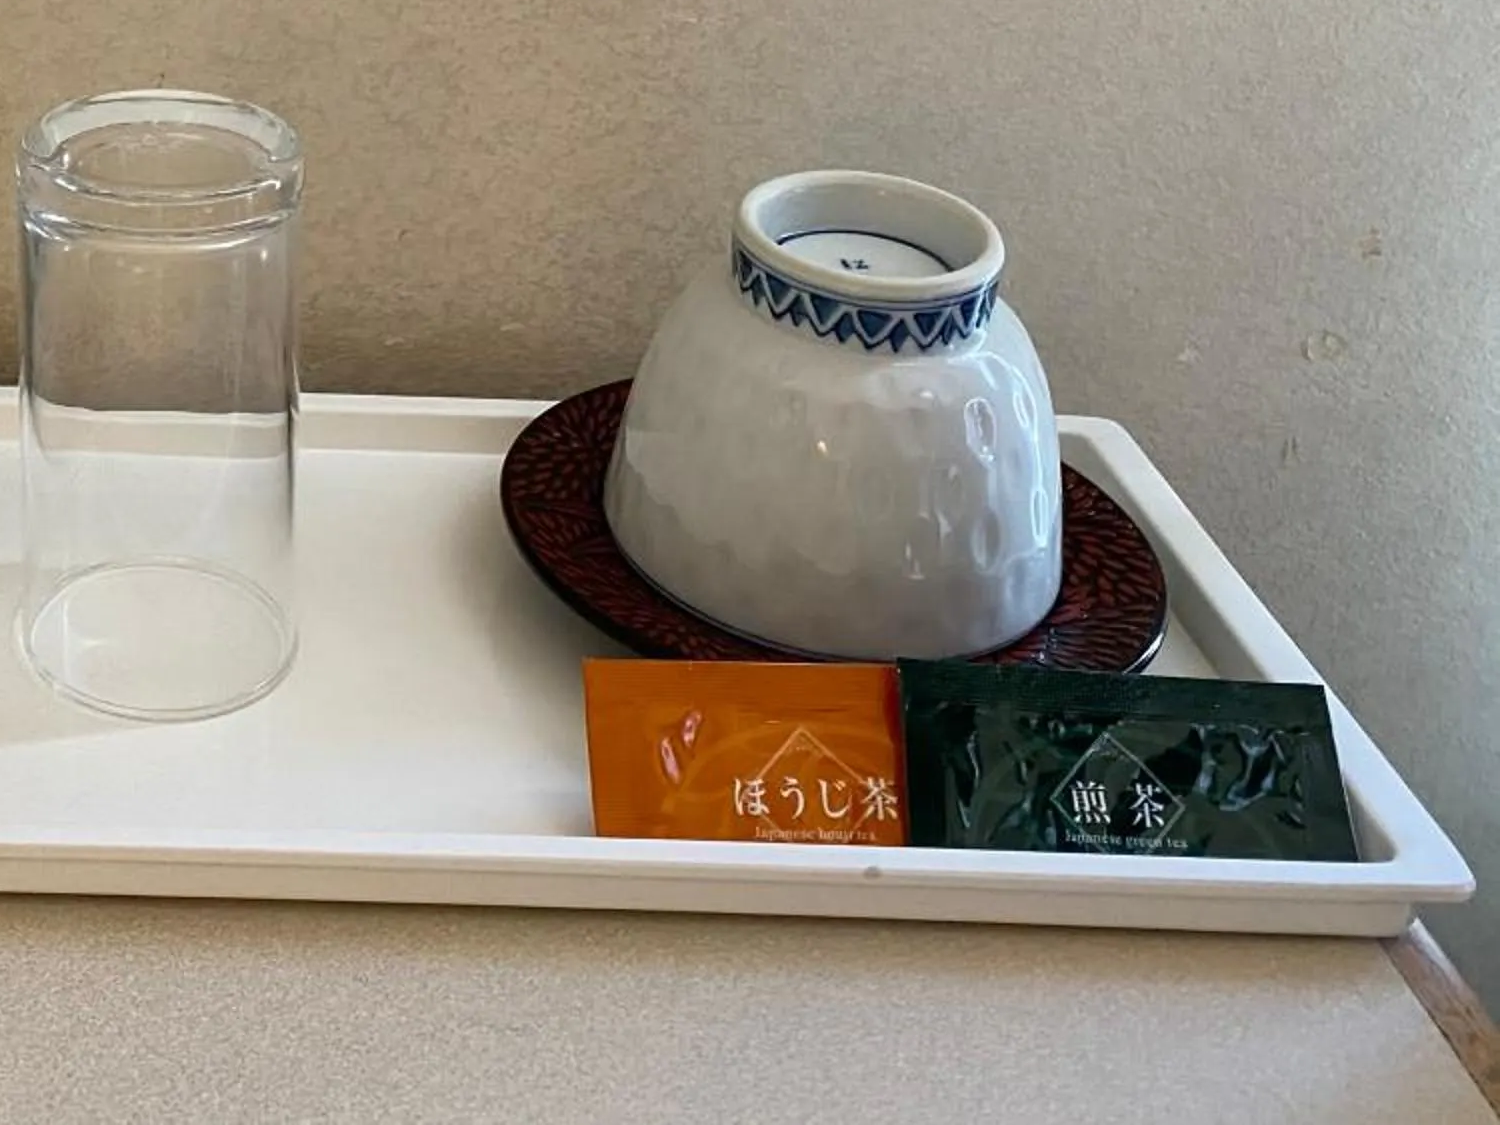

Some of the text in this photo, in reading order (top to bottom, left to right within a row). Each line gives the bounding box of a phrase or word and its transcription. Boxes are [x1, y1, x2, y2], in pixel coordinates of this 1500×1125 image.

[734, 777, 898, 820] ほうじ茶
[1071, 781, 1165, 828] 煎茶
